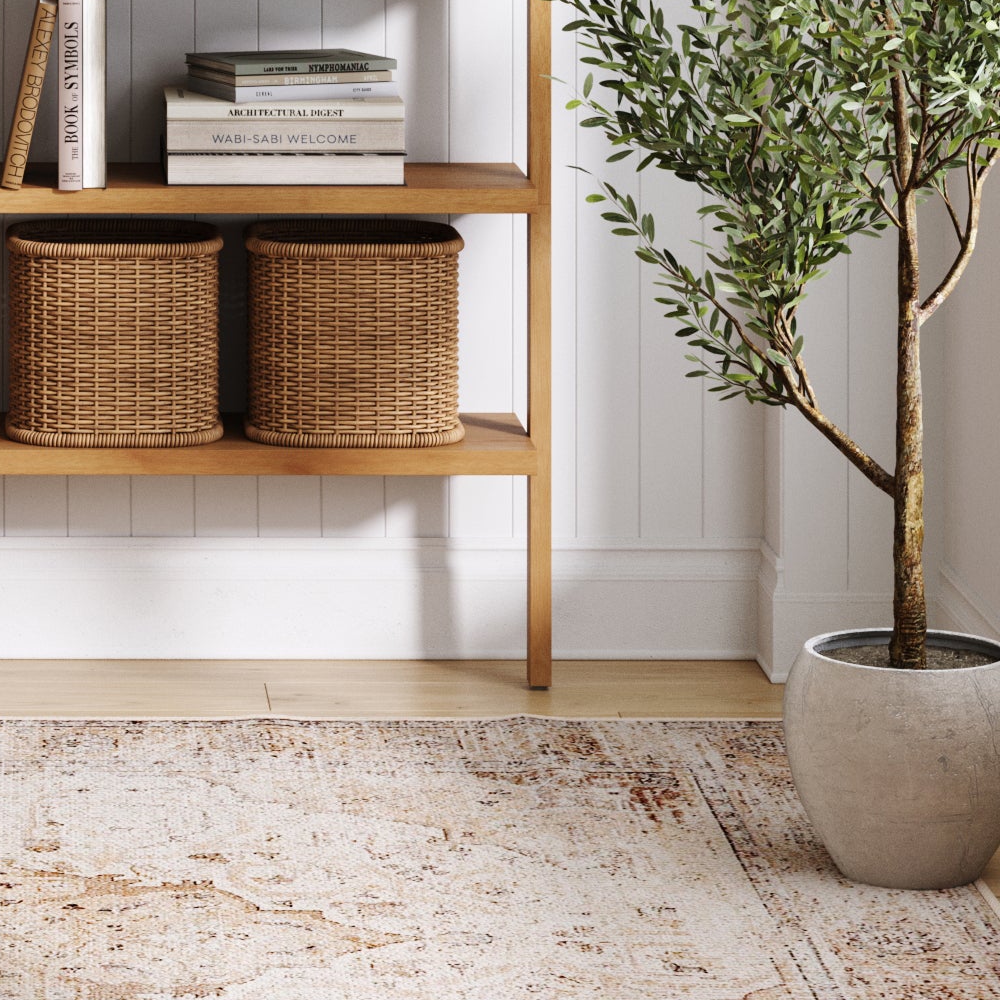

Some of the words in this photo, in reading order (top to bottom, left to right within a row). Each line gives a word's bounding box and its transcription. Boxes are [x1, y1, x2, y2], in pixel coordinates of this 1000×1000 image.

[31, 7, 57, 71] ALEXEY
[64, 21, 79, 90] SYMBOLS
[308, 62, 370, 73] NYMPHOMANIAC
[284, 75, 338, 85] BIRMINGHAM
[71, 92, 79, 102] OF
[227, 108, 309, 117] ARCHITECTURAL
[310, 108, 344, 117] DIGEST
[8, 74, 42, 177] BRODOVITCH
[64, 105, 79, 144] BOOK
[211, 134, 283, 144] WABI-SABI
[287, 134, 357, 144] WELCOME
[71, 146, 79, 160] THE
